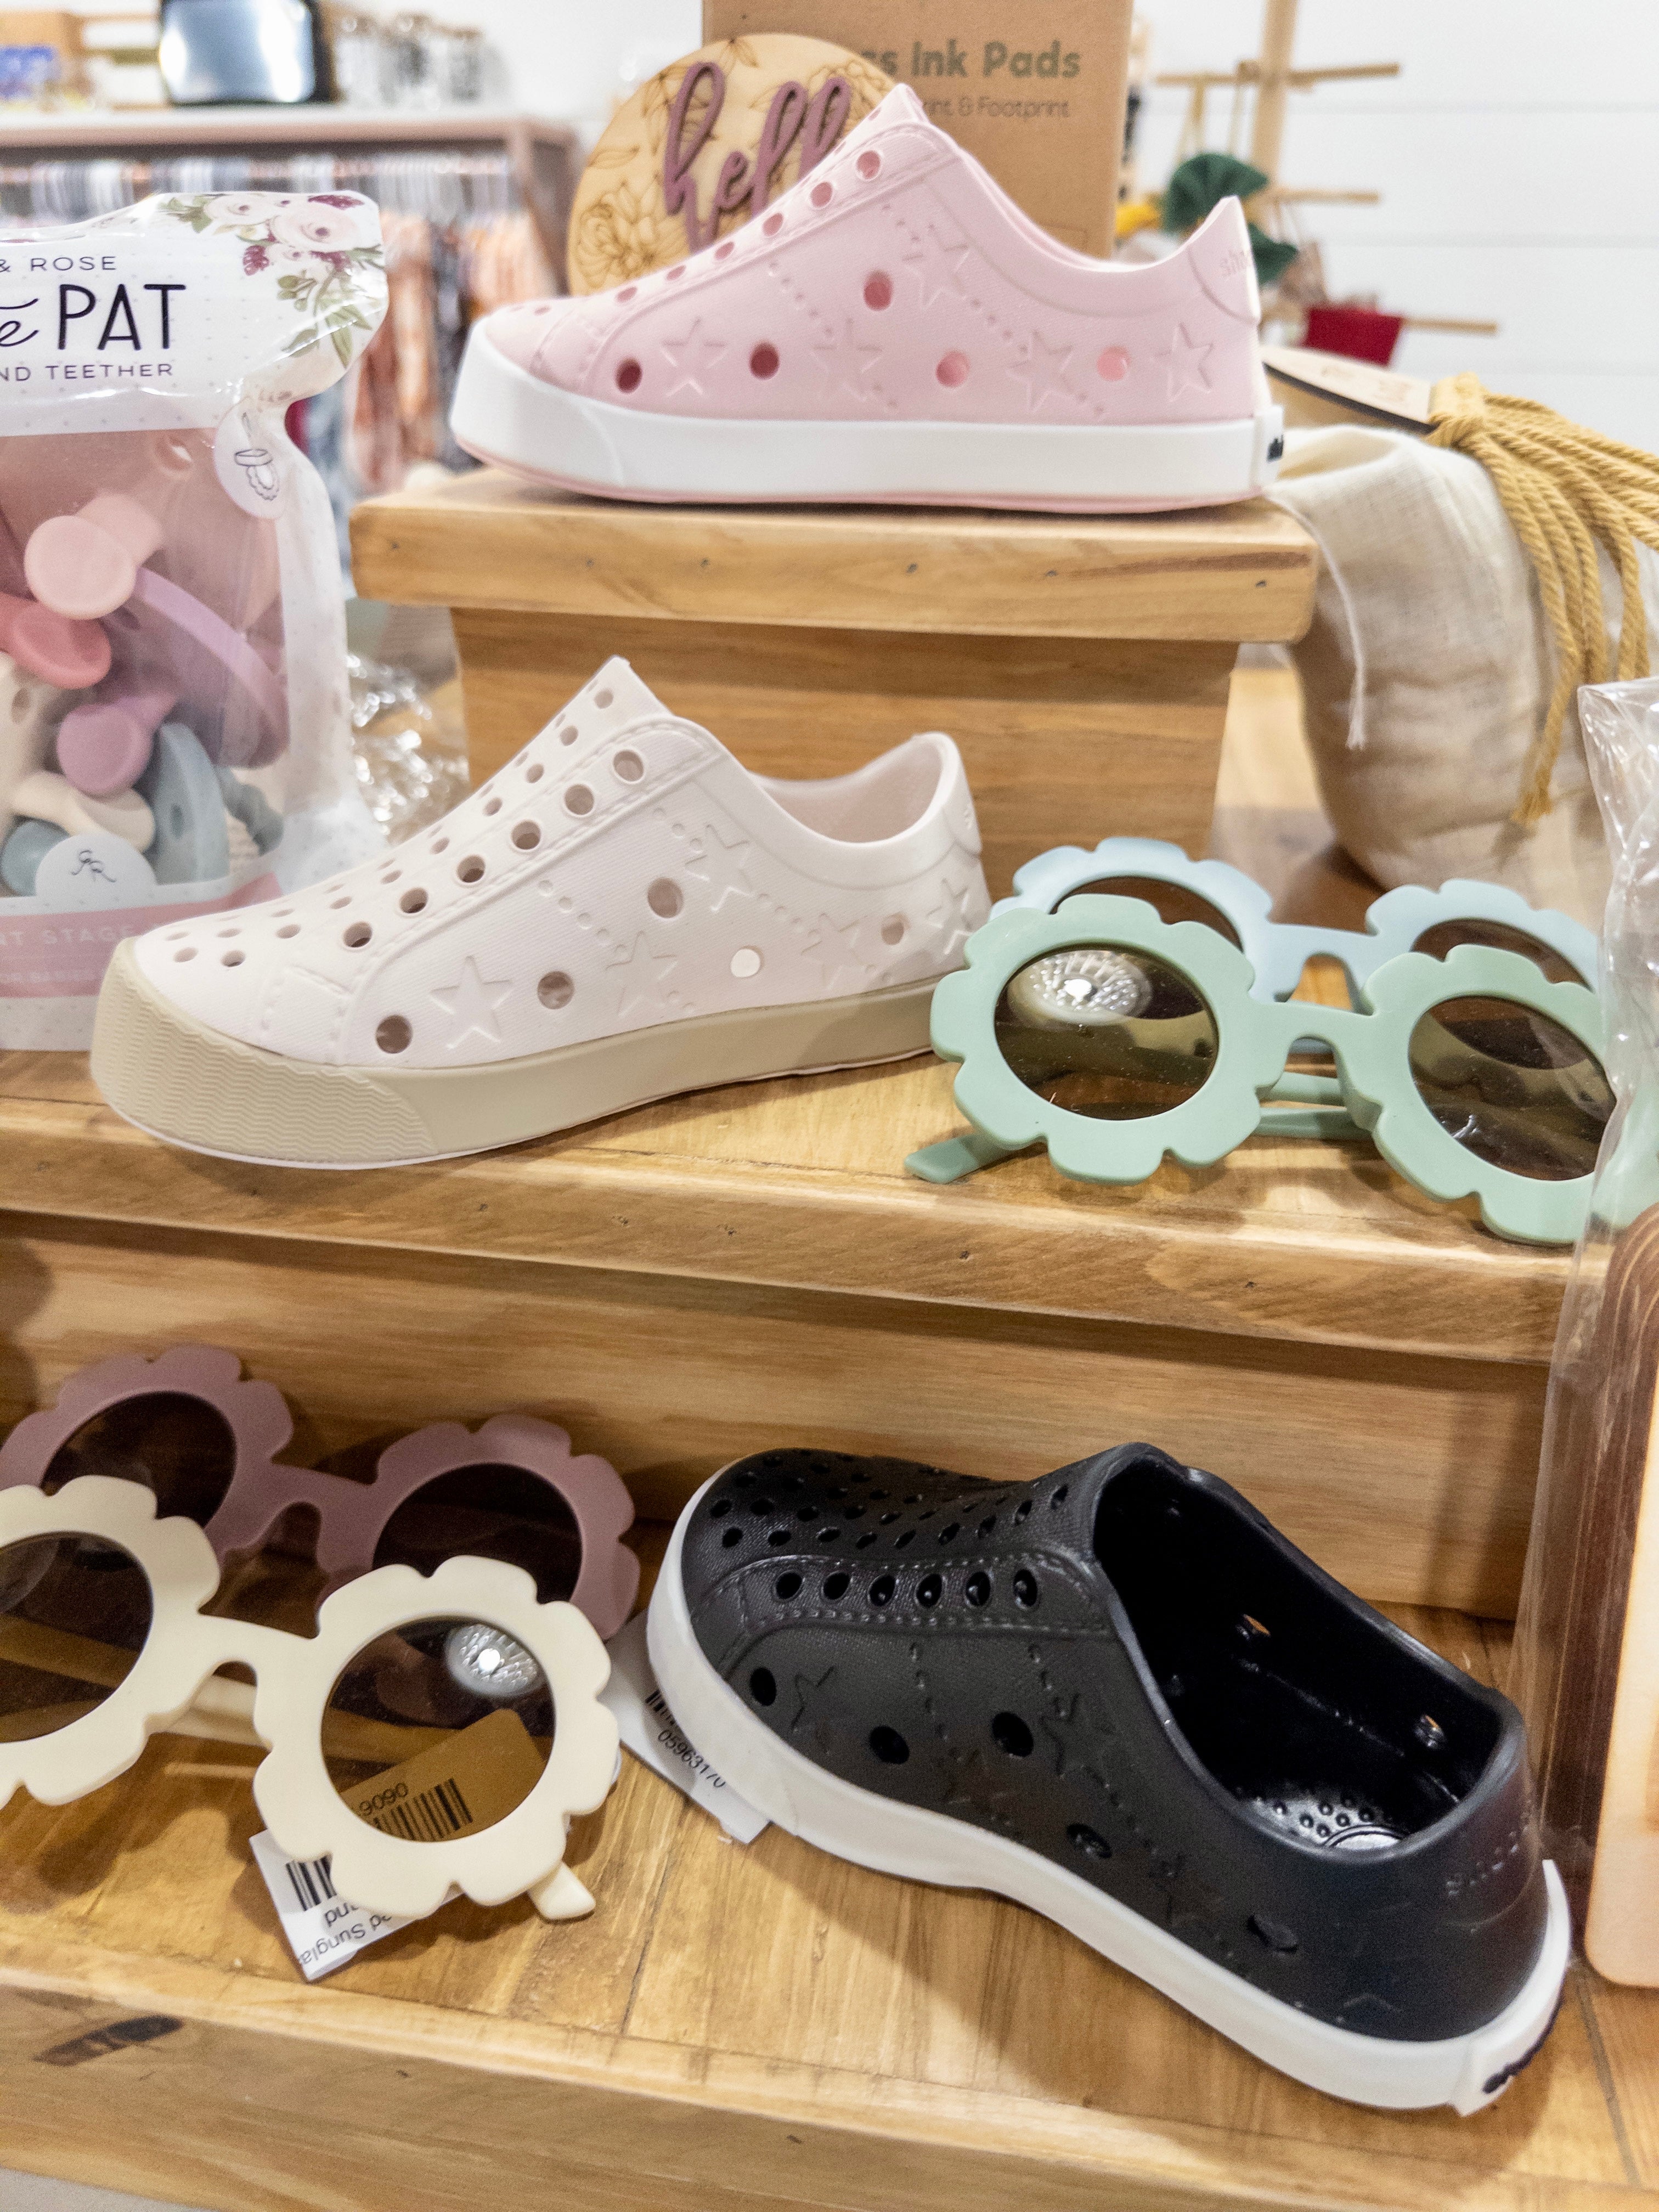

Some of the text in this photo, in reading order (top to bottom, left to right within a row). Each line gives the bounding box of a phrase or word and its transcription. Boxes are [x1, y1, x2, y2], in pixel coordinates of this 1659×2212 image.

[911, 39, 968, 77] Ink
[983, 39, 1081, 78] Pads
[977, 95, 1070, 122] Footprint
[30, 256, 117, 272] ROSE
[58, 283, 187, 351] PAT
[45, 363, 173, 380] TEETHER
[298, 1922, 366, 1965] Sungla
